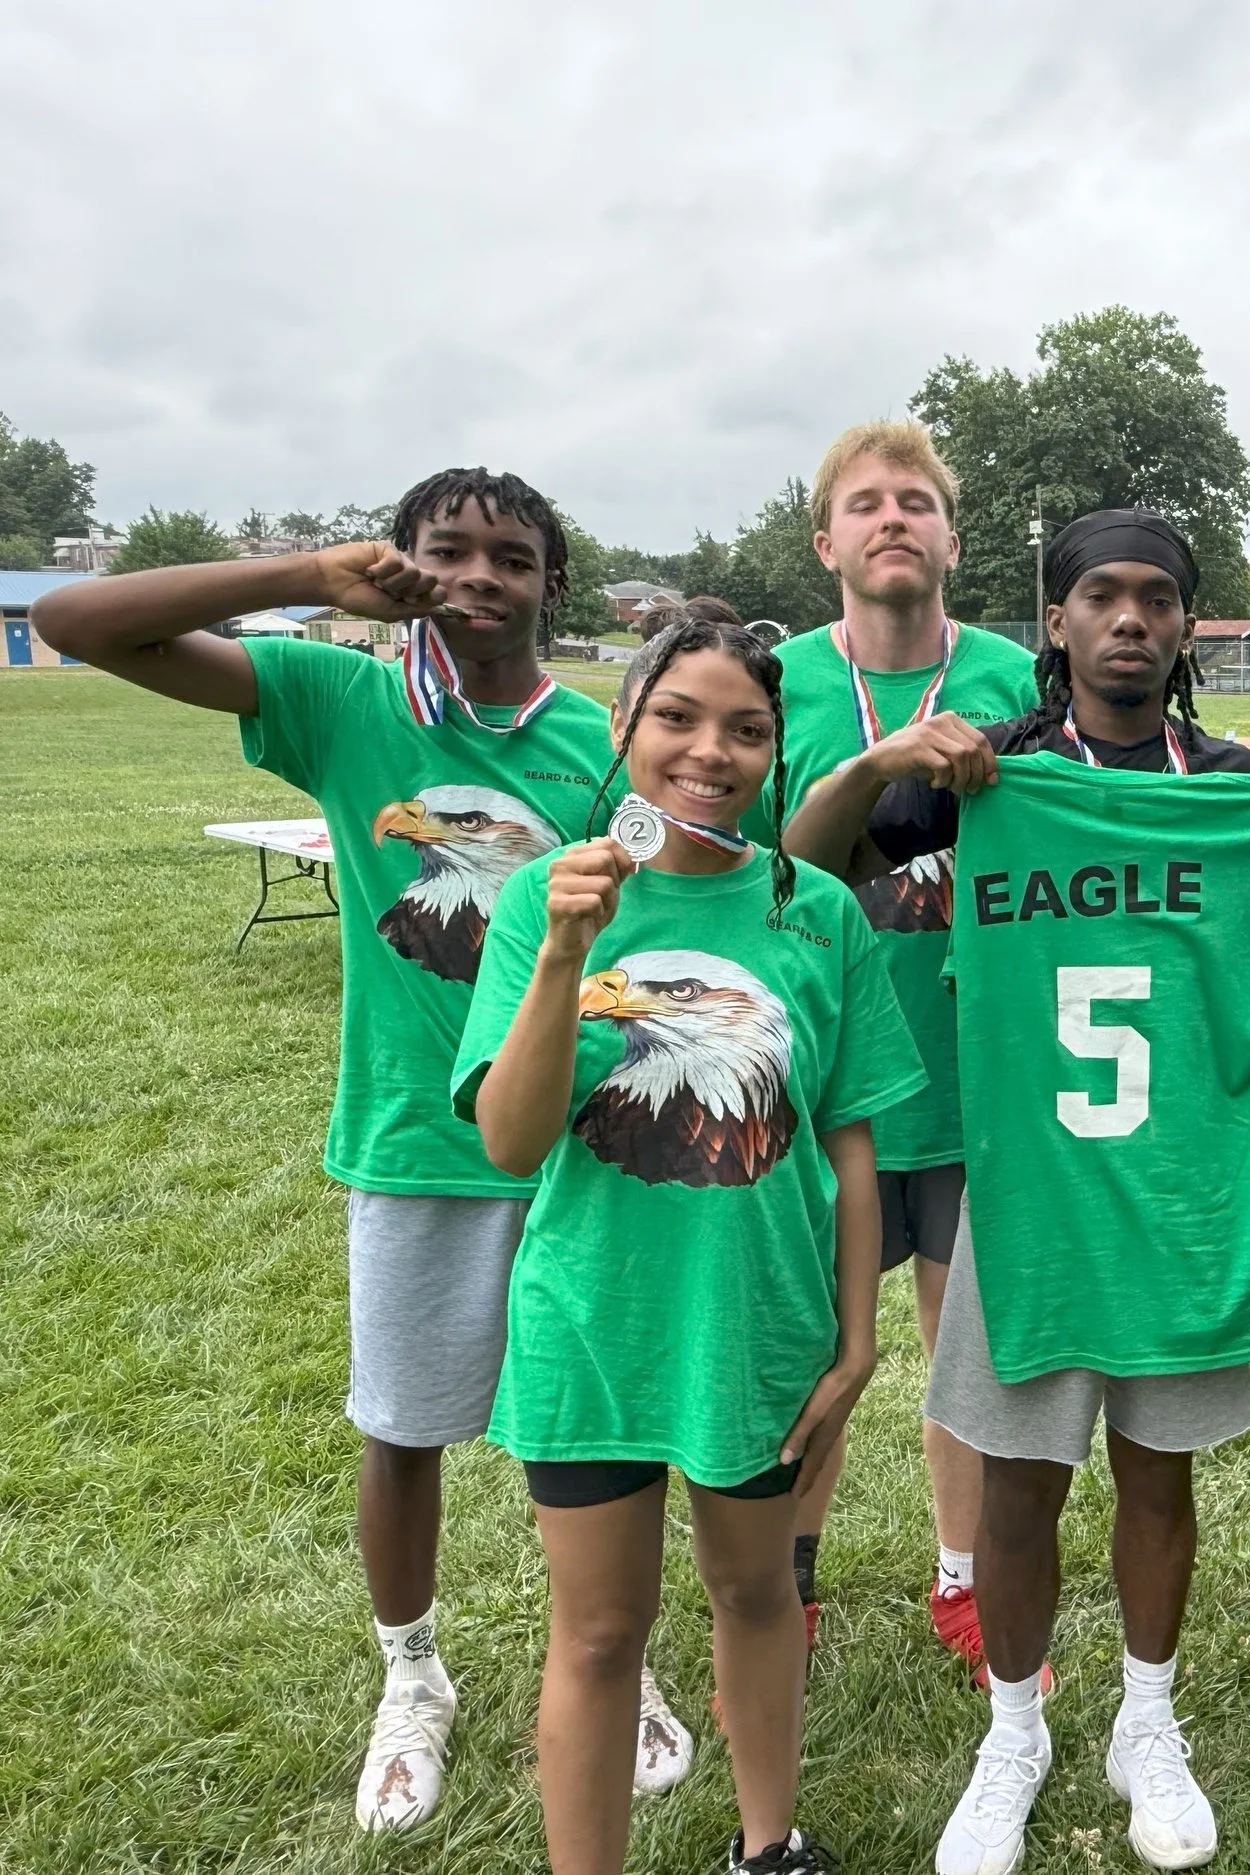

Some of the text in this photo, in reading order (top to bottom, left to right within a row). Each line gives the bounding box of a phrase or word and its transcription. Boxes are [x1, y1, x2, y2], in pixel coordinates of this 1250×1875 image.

[524, 769, 590, 786] BEARD & CO
[629, 818, 648, 841] 2
[973, 861, 1202, 926] EAGLE
[805, 931, 813, 942] &
[814, 935, 832, 948] CO
[1056, 965, 1151, 1138] 5
